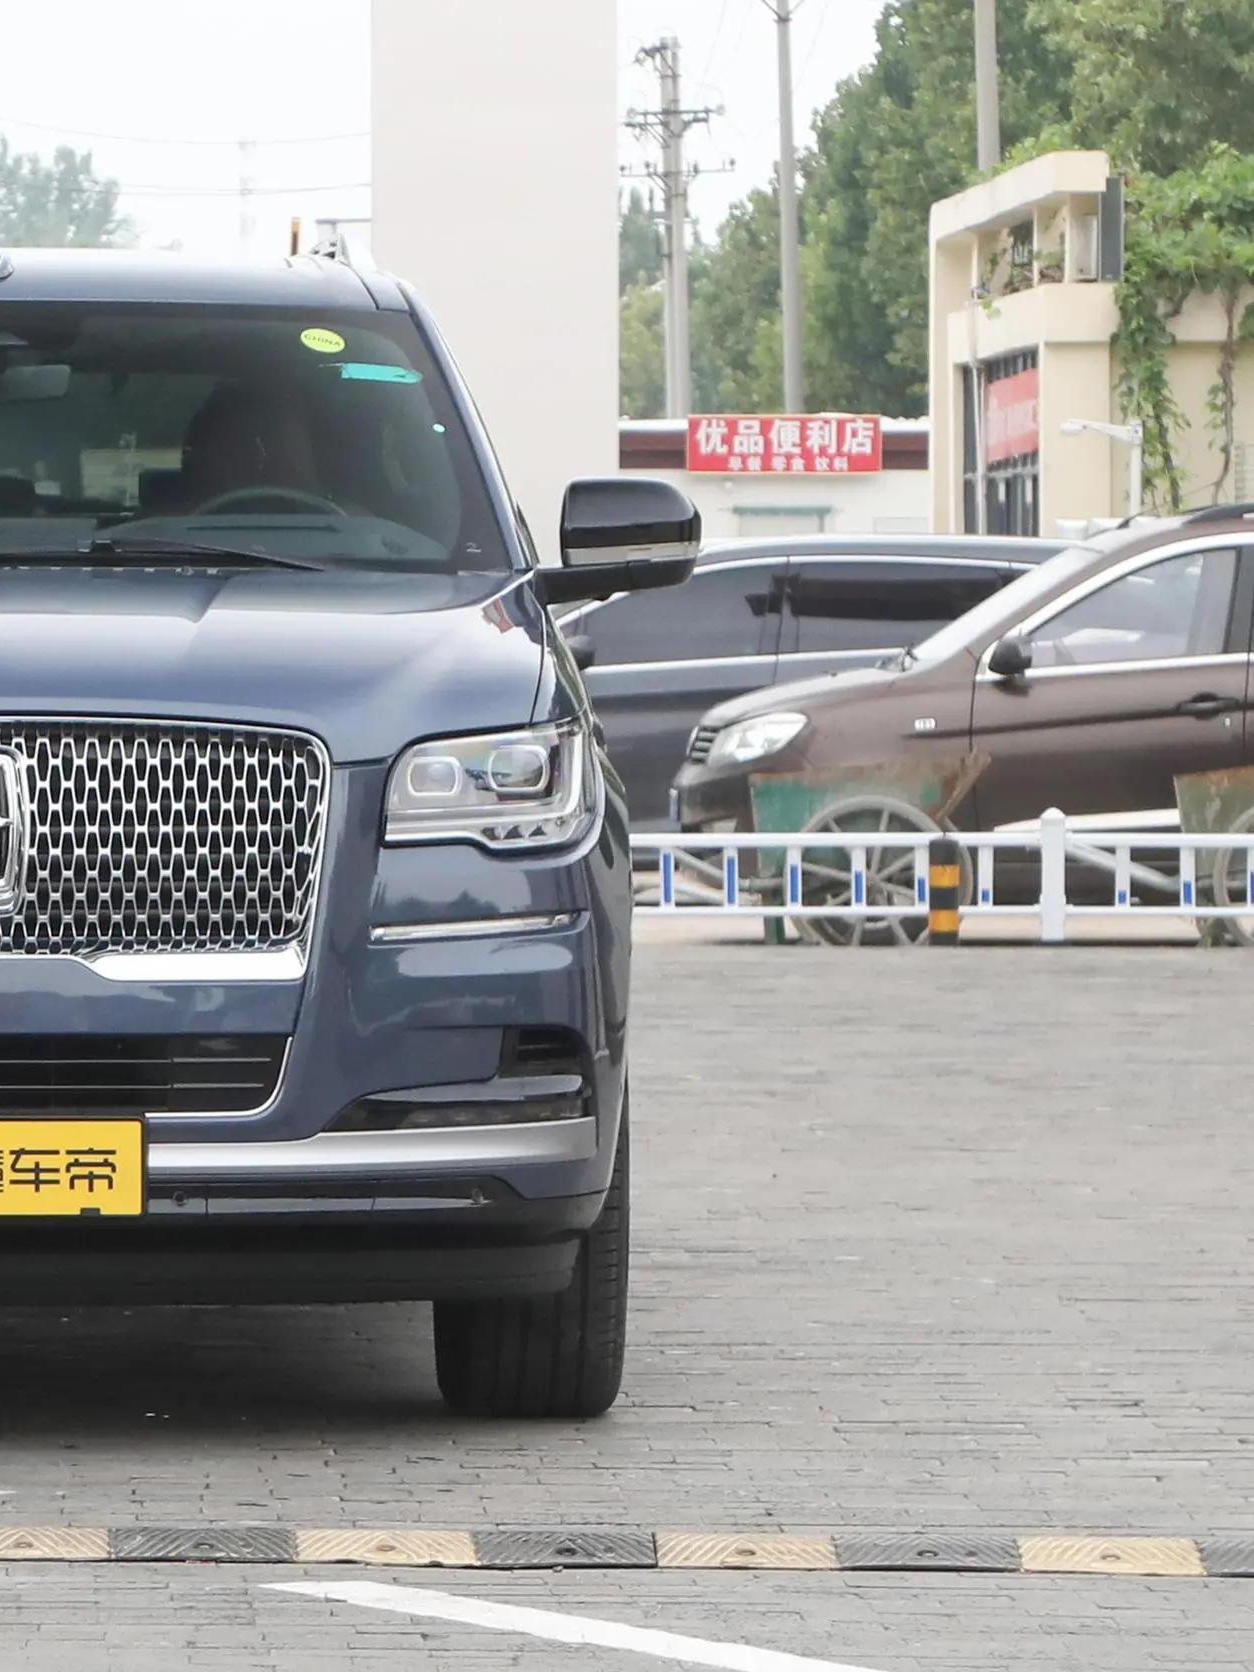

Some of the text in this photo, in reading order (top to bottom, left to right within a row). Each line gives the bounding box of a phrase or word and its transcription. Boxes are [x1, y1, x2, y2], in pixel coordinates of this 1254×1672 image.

[696, 419, 874, 455] 优品便利店
